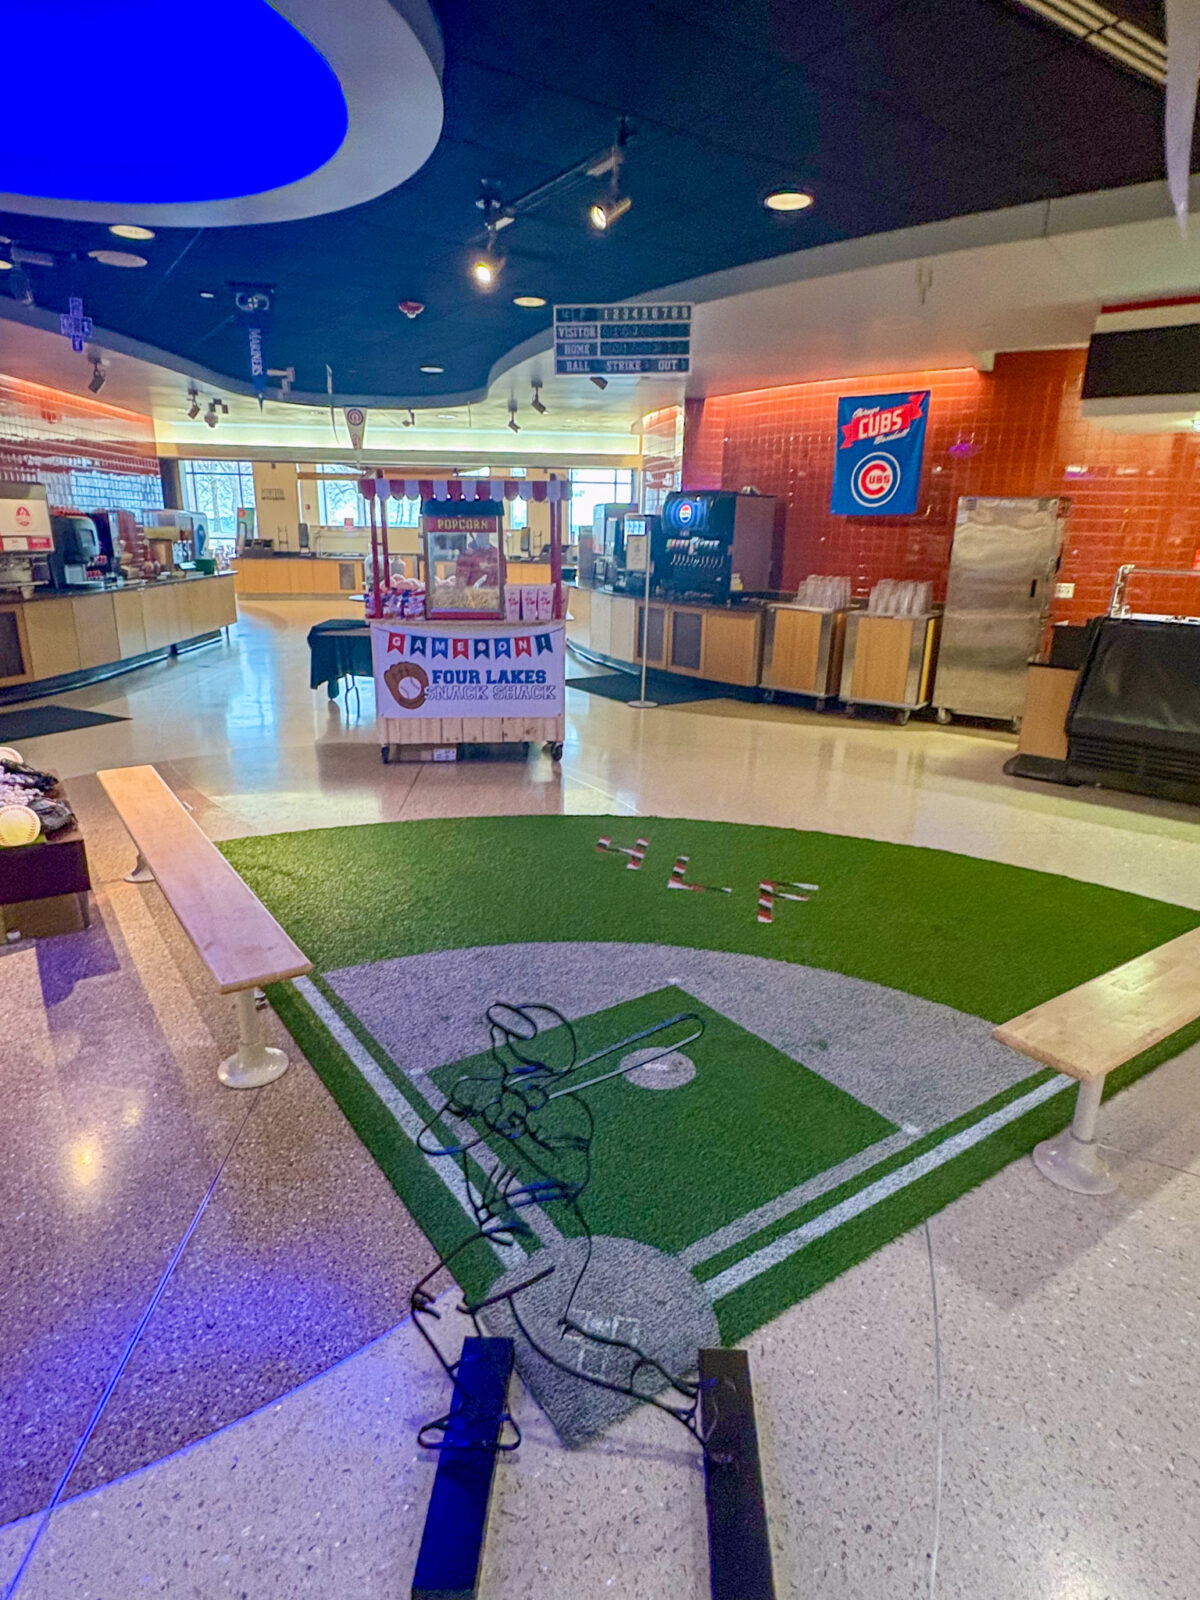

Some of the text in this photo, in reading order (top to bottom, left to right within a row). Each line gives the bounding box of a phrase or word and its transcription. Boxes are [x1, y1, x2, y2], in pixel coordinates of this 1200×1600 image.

[558, 326, 596, 338] VISITOR
[249, 328, 263, 376] MARINERS
[564, 344, 591, 355] HOME
[566, 360, 590, 372] BALL
[606, 359, 642, 371] STRIKE
[658, 359, 678, 371] OUT
[858, 409, 903, 440] CUBS
[437, 518, 489, 531] POPCORN
[391, 636, 465, 652] GAME
[431, 669, 547, 685] FOUR LAKES
[424, 684, 557, 701] SNACK SHACK
